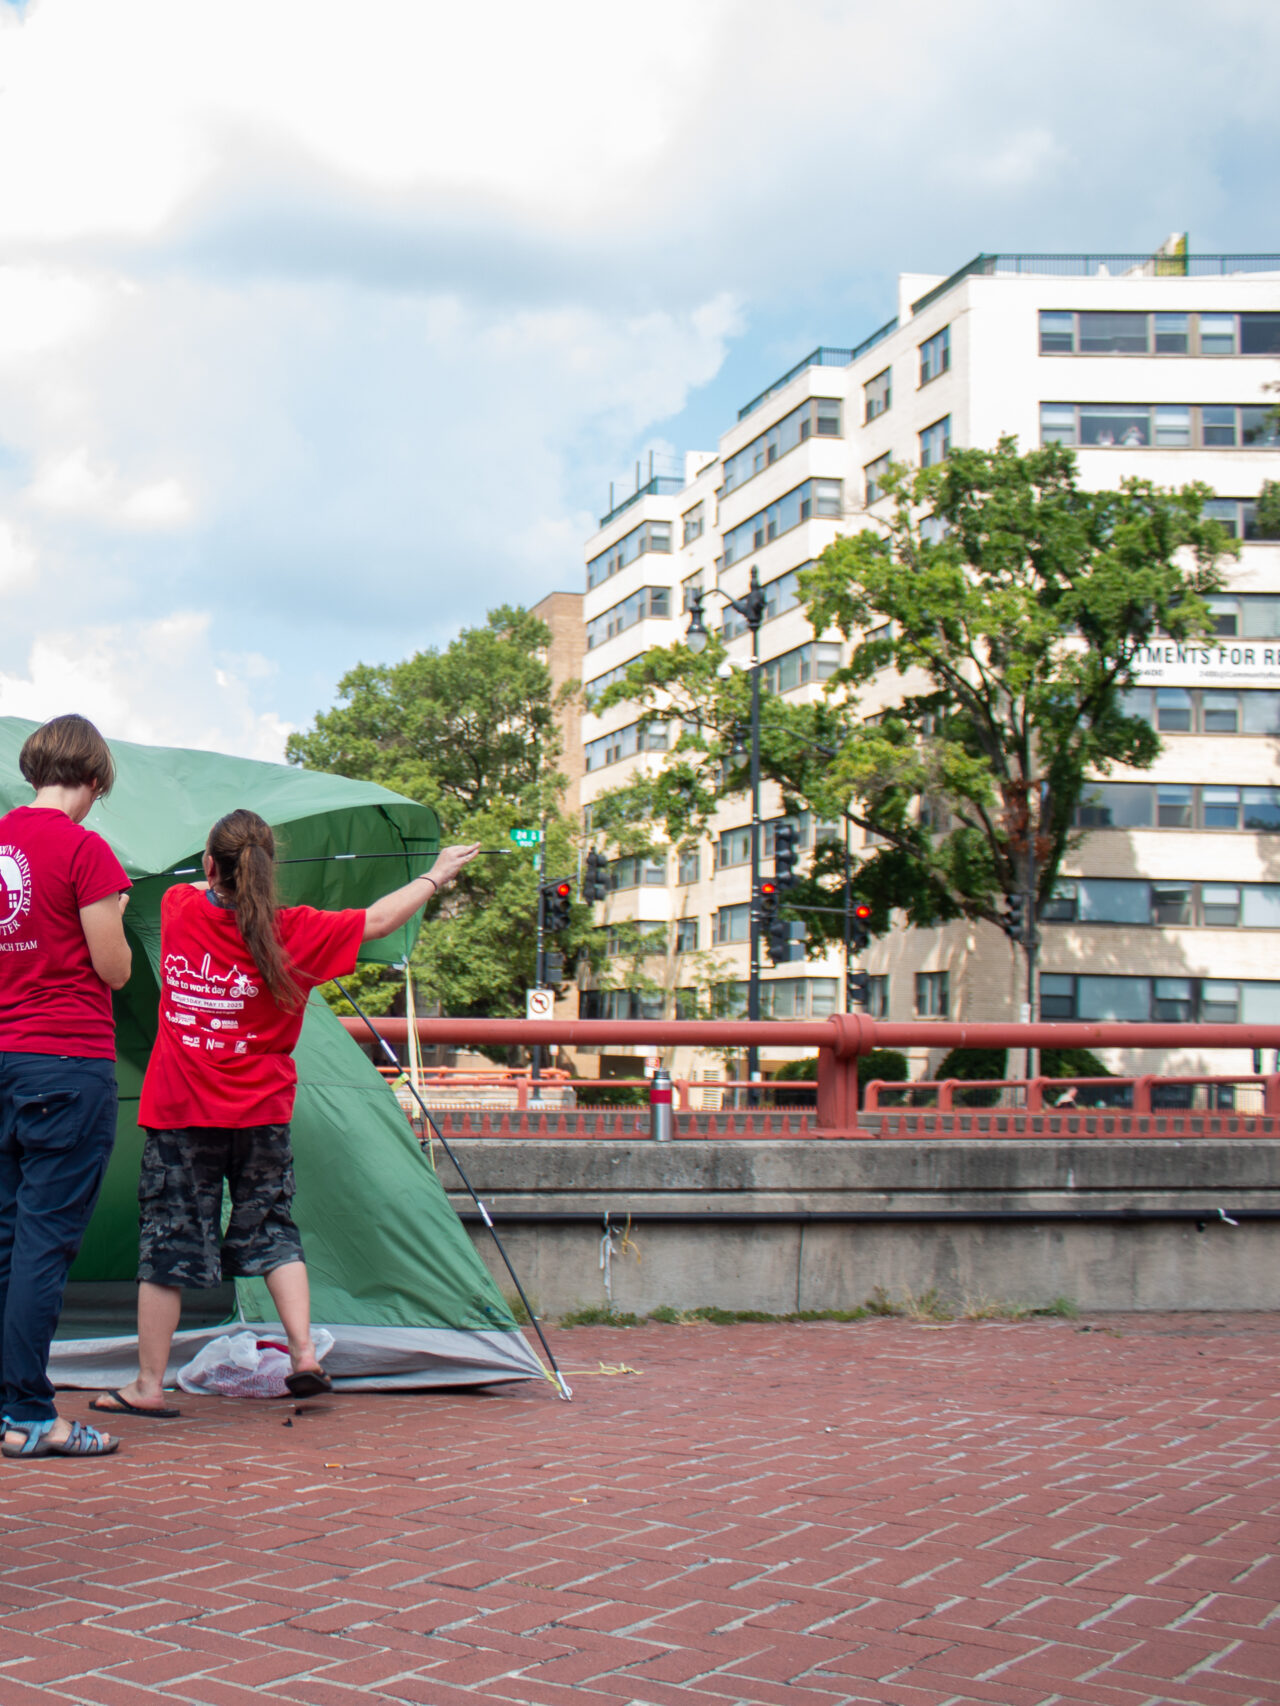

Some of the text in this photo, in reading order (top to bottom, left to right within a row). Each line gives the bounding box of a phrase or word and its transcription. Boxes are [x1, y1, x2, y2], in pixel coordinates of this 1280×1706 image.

[1219, 648, 1256, 665] FOR
[13, 849, 32, 917] MINISTRY
[15, 940, 38, 952] TEAM
[166, 974, 226, 997] bike to work day
